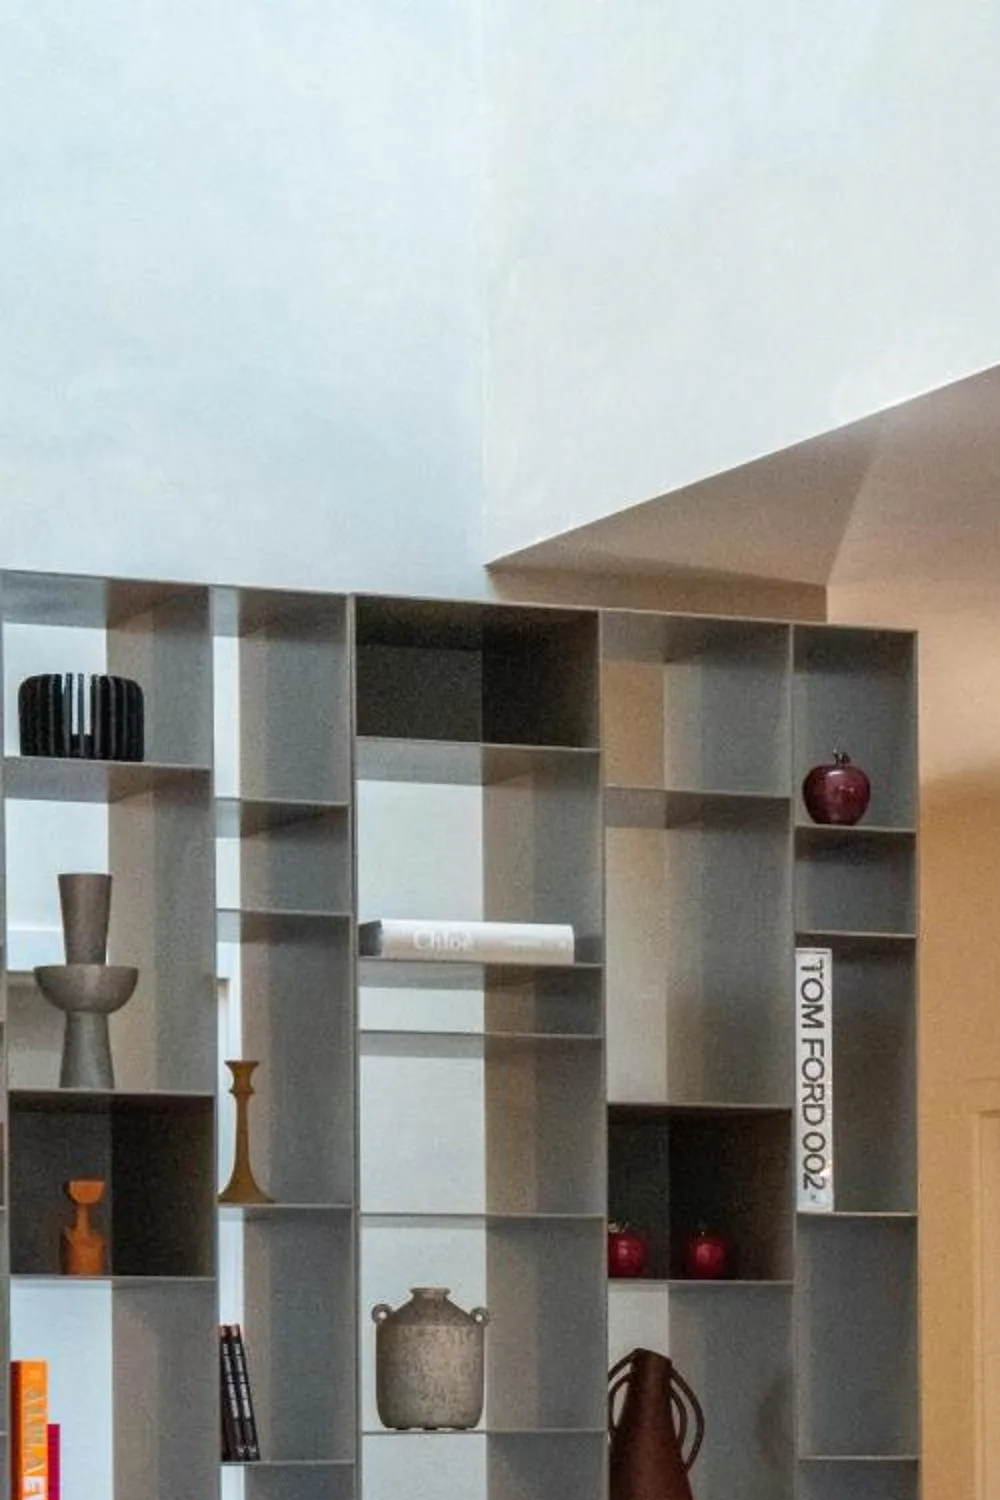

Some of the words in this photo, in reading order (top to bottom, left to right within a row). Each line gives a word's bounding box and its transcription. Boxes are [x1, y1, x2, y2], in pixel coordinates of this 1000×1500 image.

[800, 958, 825, 1030] TOM
[801, 1037, 825, 1127] FORD
[801, 1131, 827, 1191] 002
